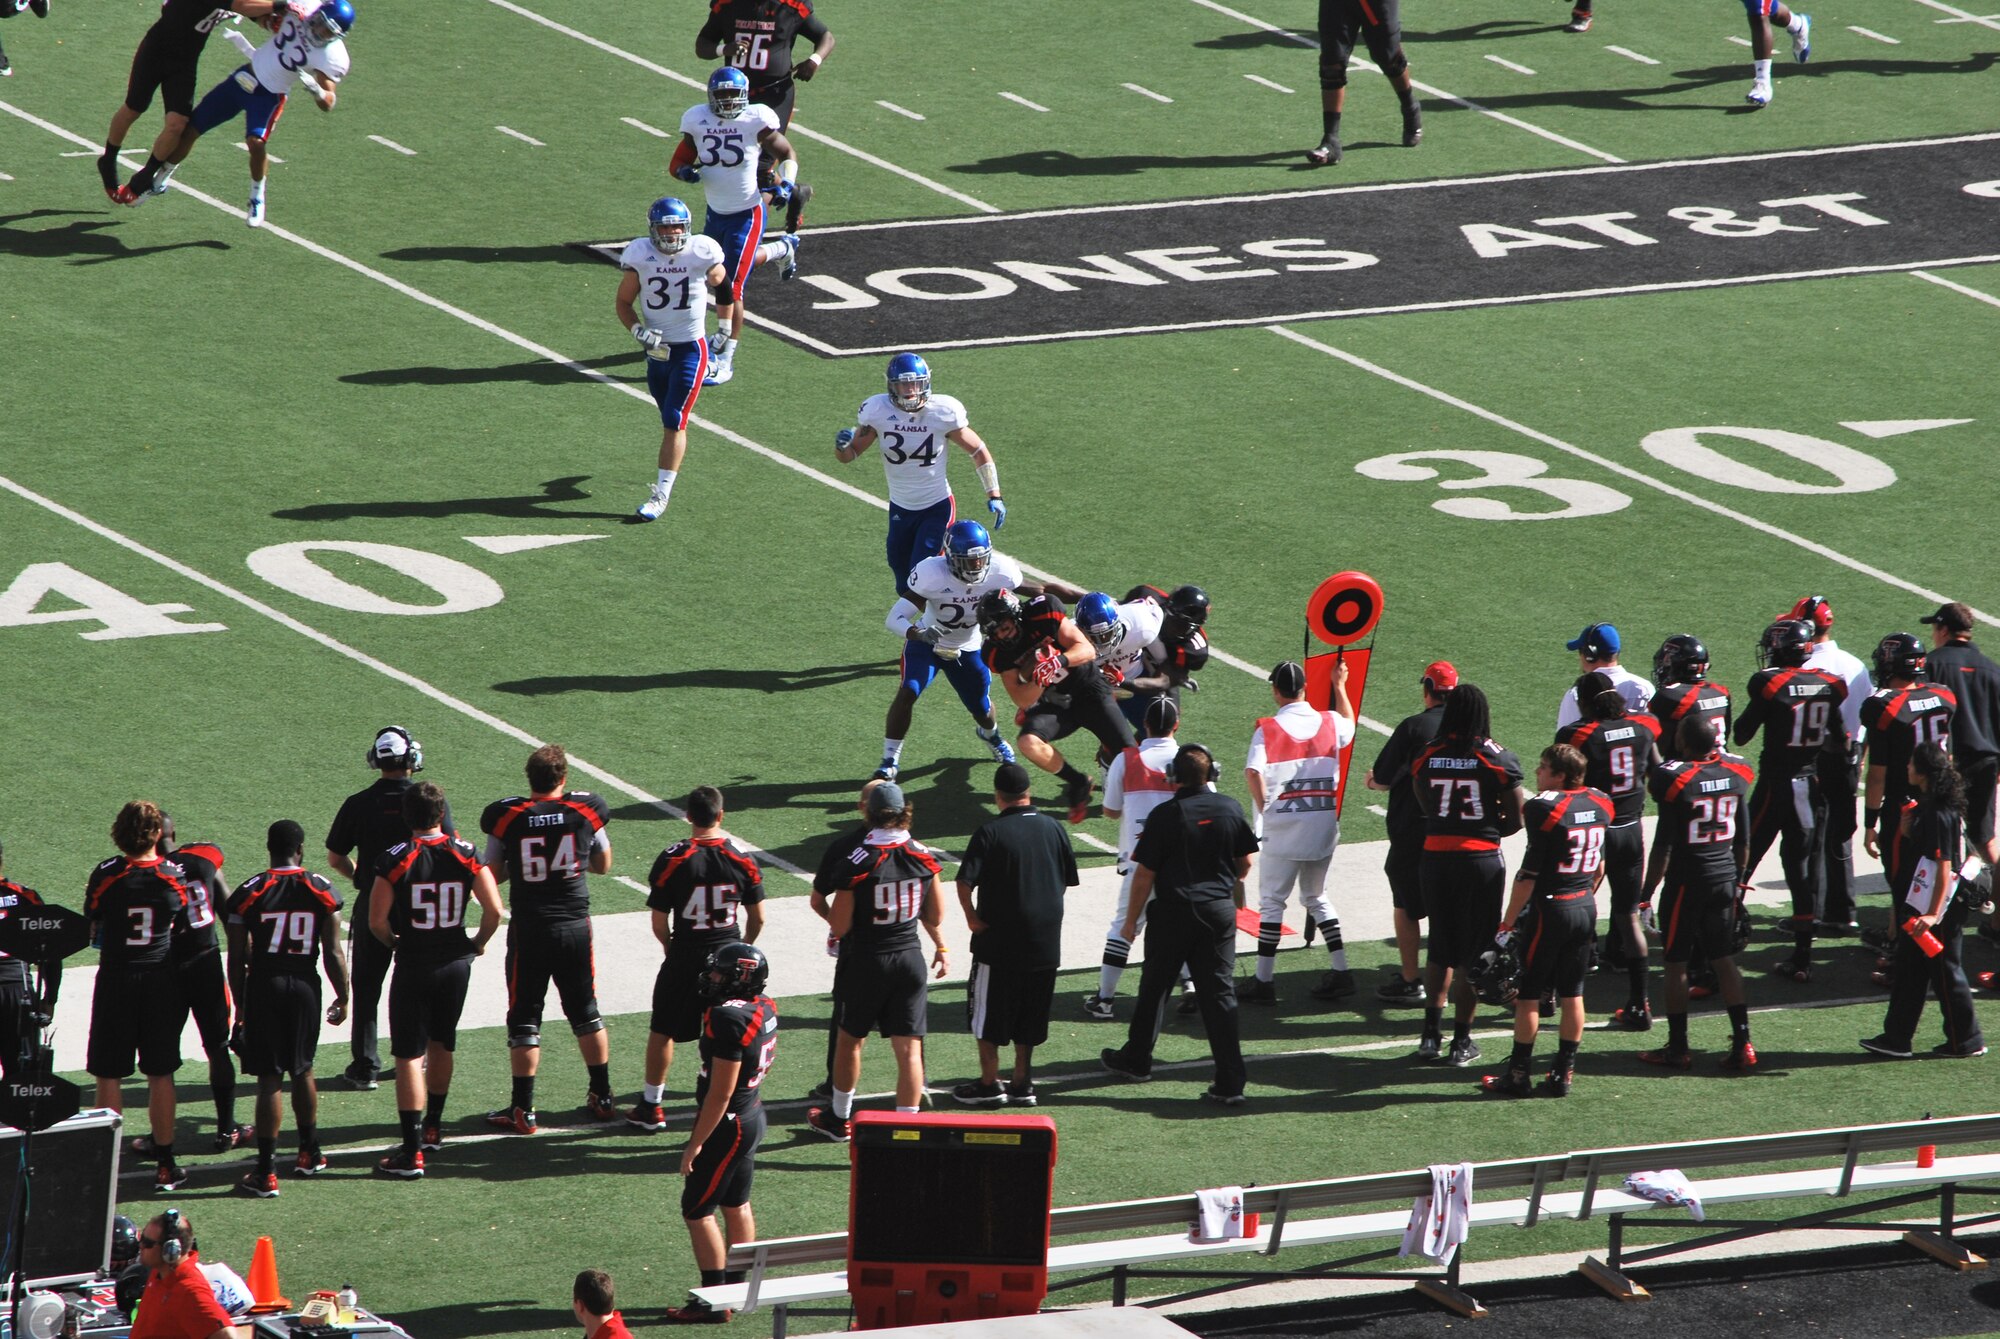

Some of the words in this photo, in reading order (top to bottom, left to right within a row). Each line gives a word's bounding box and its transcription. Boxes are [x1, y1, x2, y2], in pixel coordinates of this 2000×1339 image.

[274, 20, 307, 72] 33
[699, 134, 745, 168] 35
[1460, 191, 1890, 259] AT&T
[656, 266, 687, 274] KANSAS
[798, 237, 1380, 310] JONES
[646, 276, 692, 311] 31
[883, 431, 938, 468] 34
[894, 424, 928, 433] KANSAS
[1787, 700, 1831, 748] 19
[1610, 745, 1634, 794] 9
[528, 812, 565, 828] FOSTER
[1429, 778, 1484, 821] 73
[1688, 795, 1739, 844] 29
[520, 834, 581, 883] 64
[1557, 826, 1606, 874] 38
[19, 917, 63, 930] Telex
[411, 881, 464, 930] 50
[681, 883, 738, 930] 45
[872, 877, 923, 925] 90
[126, 906, 154, 946] 3
[260, 911, 316, 955] 79
[9, 1083, 53, 1097] Telex
